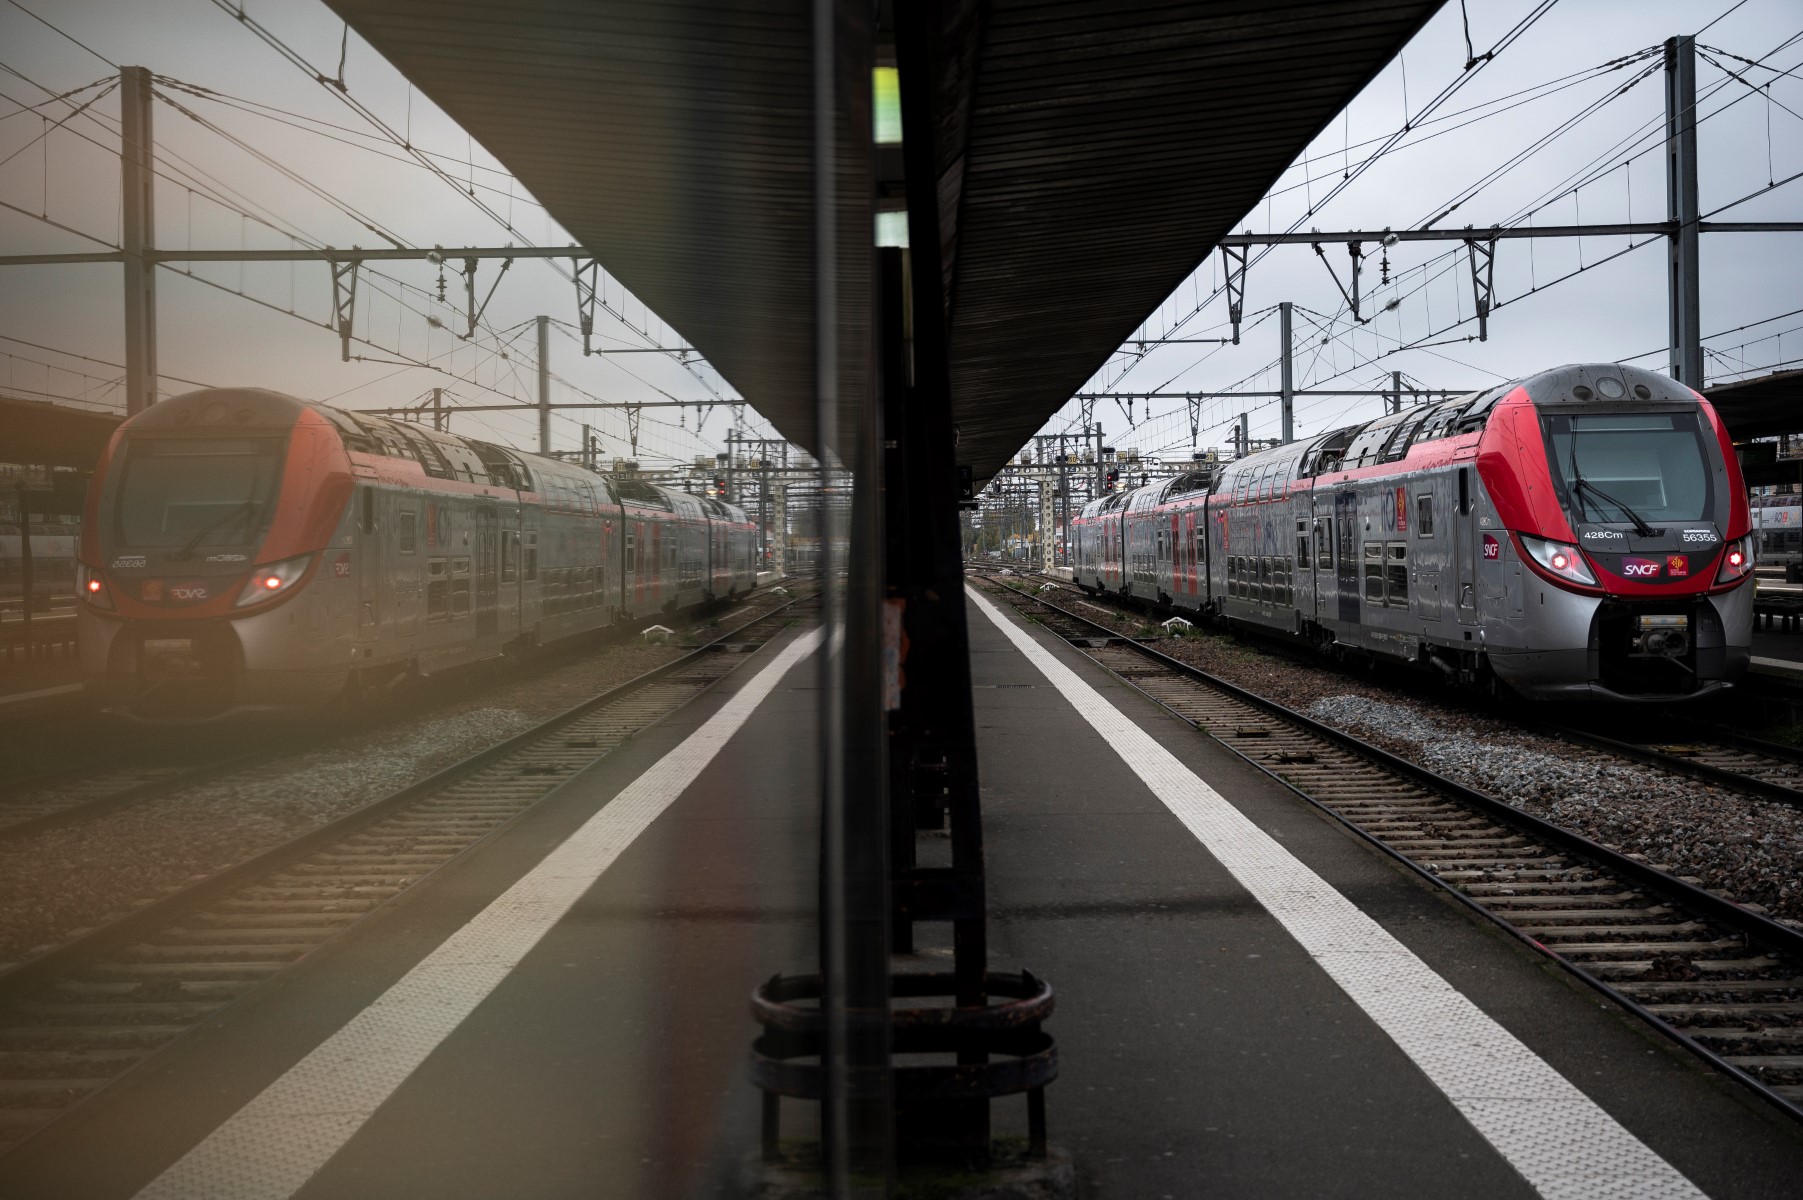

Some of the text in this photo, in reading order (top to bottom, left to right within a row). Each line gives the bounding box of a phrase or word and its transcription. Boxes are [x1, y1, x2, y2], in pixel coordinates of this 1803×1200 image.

[1584, 531, 1623, 539] 428Cm
[1682, 533, 1717, 542] 56355
[1484, 543, 1498, 556] SNCF
[1624, 565, 1658, 575] SNCF
